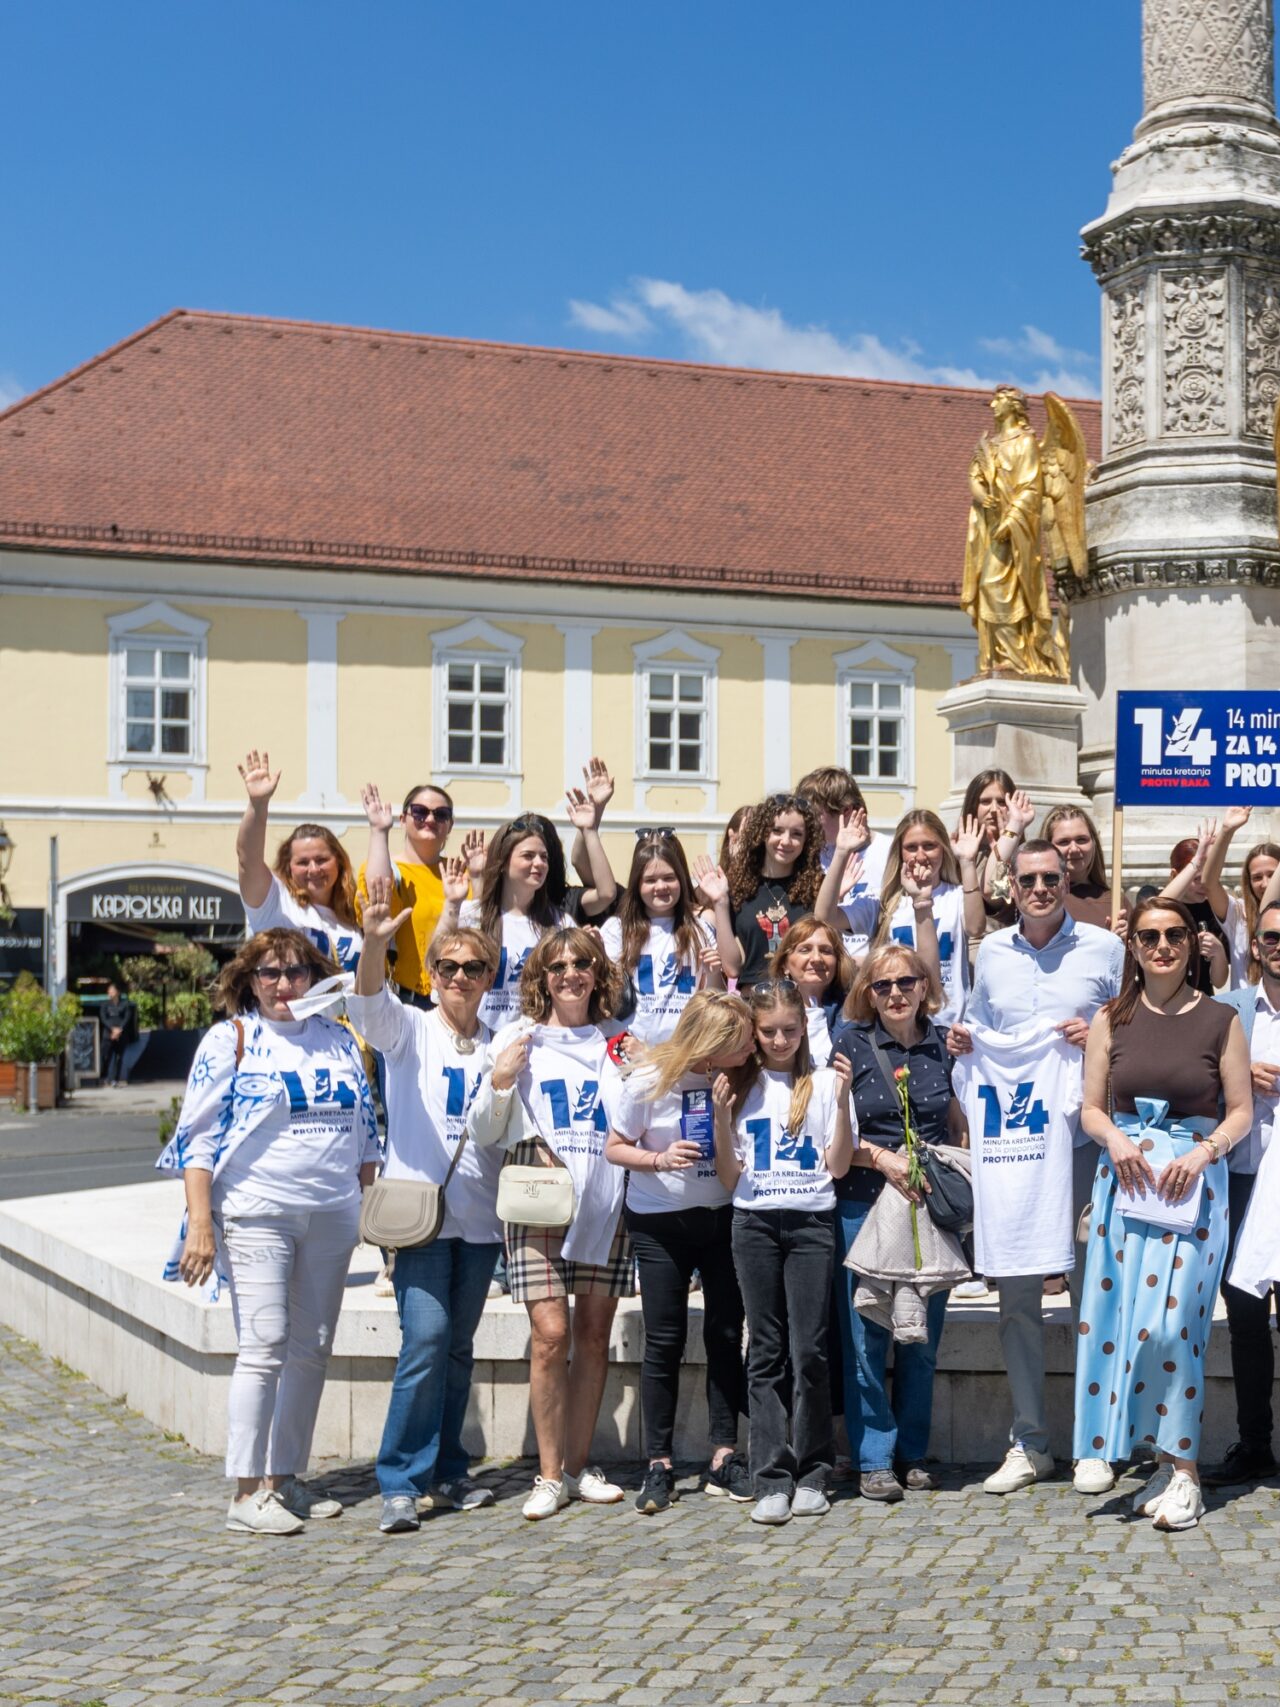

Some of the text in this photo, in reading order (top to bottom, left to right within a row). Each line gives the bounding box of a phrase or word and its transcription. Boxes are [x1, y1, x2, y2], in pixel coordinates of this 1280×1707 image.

[1226, 708, 1245, 729] 14
[1134, 708, 1217, 765] 14
[1225, 735, 1251, 755] ZA
[1255, 735, 1277, 755] 14
[1141, 767, 1211, 777] minuta kretanja
[1140, 778, 1210, 787] PROTIV RAKA
[92, 894, 222, 920] KAPTOLSKA KLET
[279, 1068, 357, 1113] 14
[540, 1078, 607, 1132] 14
[978, 1081, 1049, 1138] 14
[292, 1127, 326, 1135] PROTIV
[1011, 1135, 1045, 1144] KRETANJA
[746, 1117, 819, 1171] 14
[982, 1152, 1045, 1164] PROTIV RAKA!
[697, 1169, 718, 1178] PRO
[753, 1186, 818, 1197] PROTIV RAKA!
